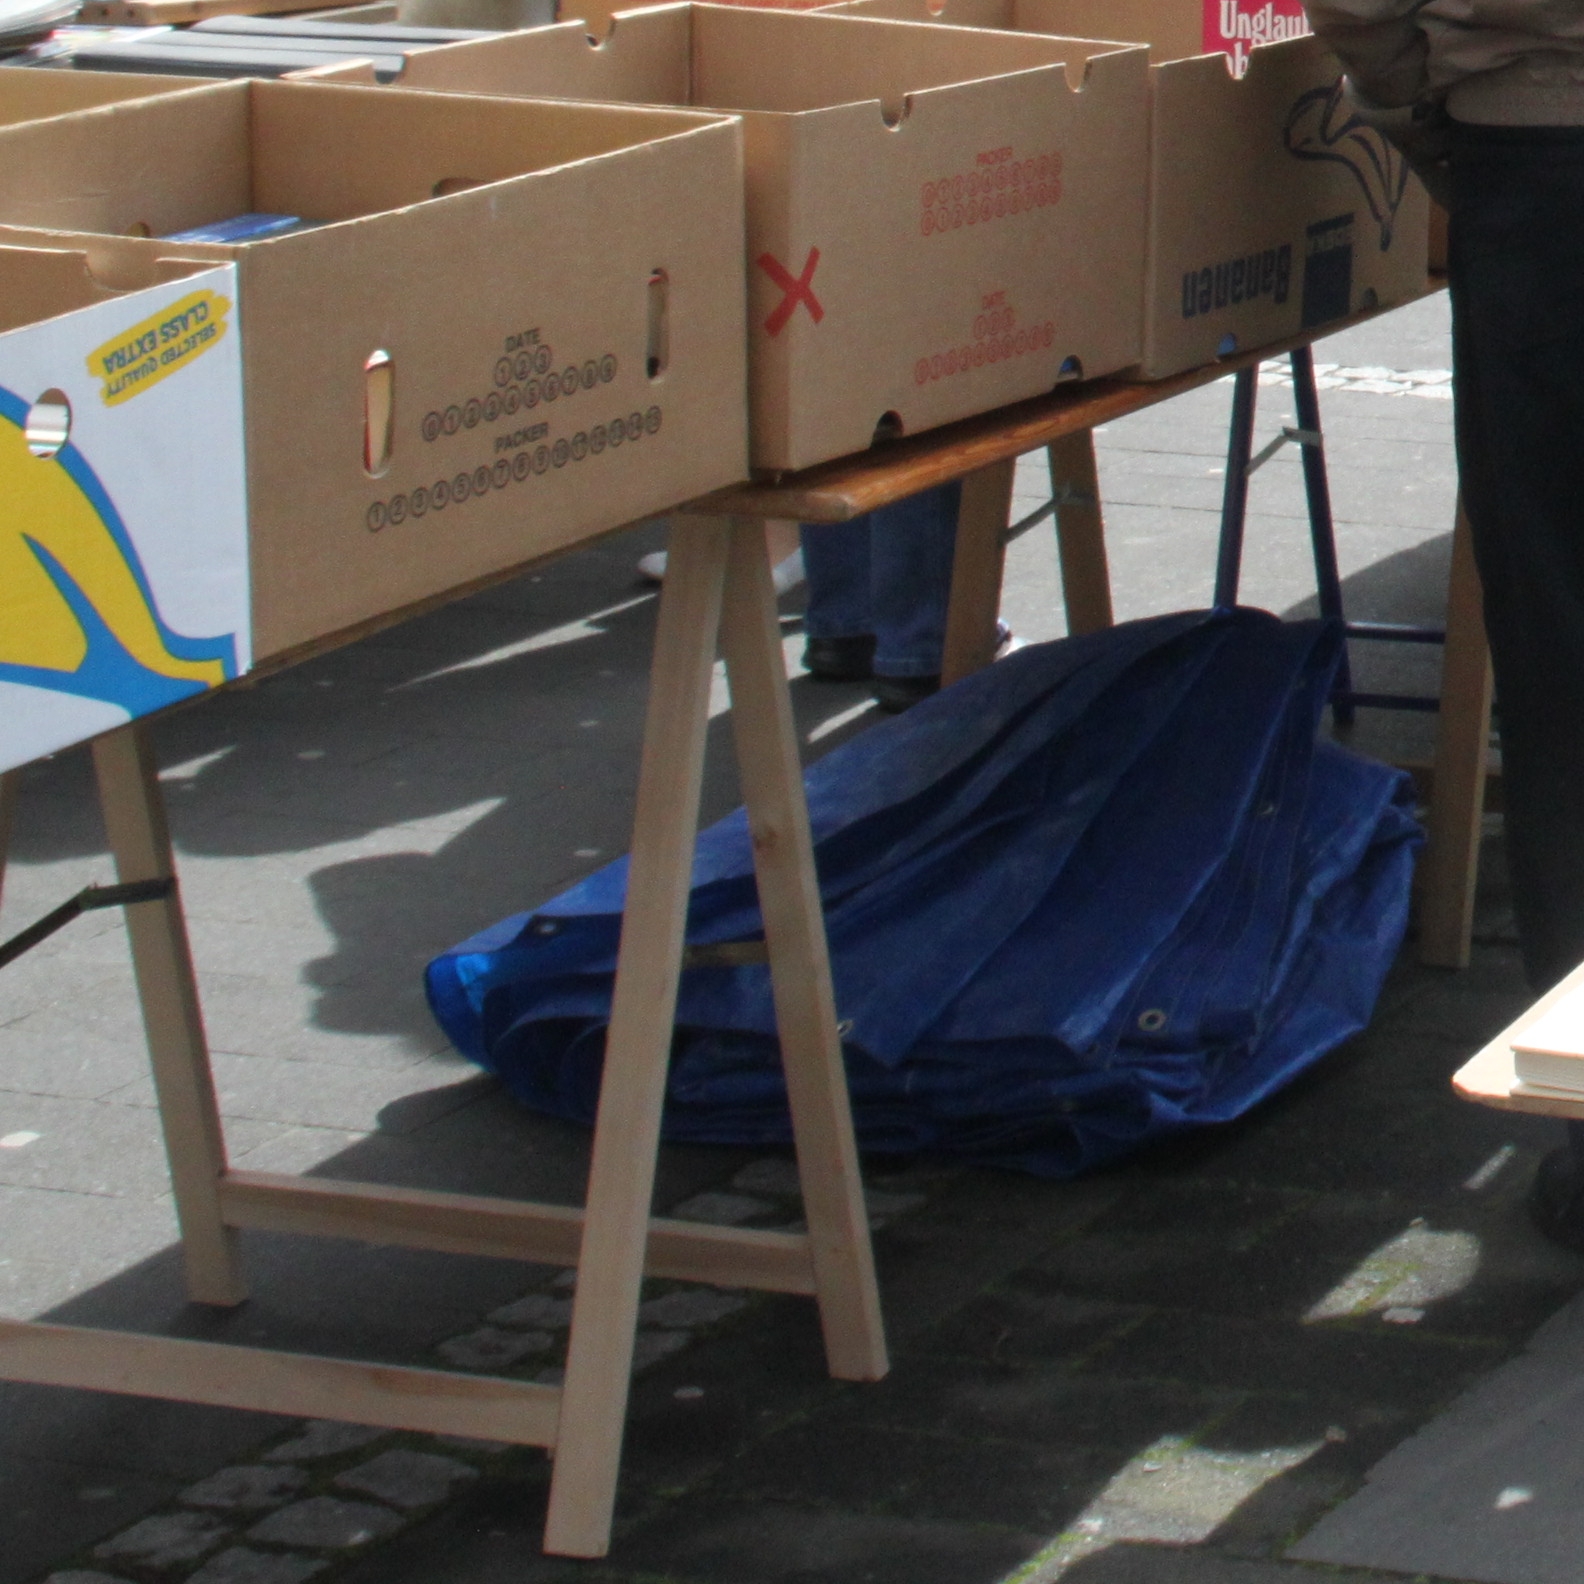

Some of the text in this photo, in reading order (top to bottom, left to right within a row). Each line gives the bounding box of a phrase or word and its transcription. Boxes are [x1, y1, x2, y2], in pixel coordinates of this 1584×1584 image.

[1181, 243, 1292, 320] Bananen
[102, 300, 209, 375] CLASS EXTRA
[105, 321, 217, 400] SELECTED QUALITY
[504, 327, 541, 353] DATE
[494, 421, 549, 454] PACKER
